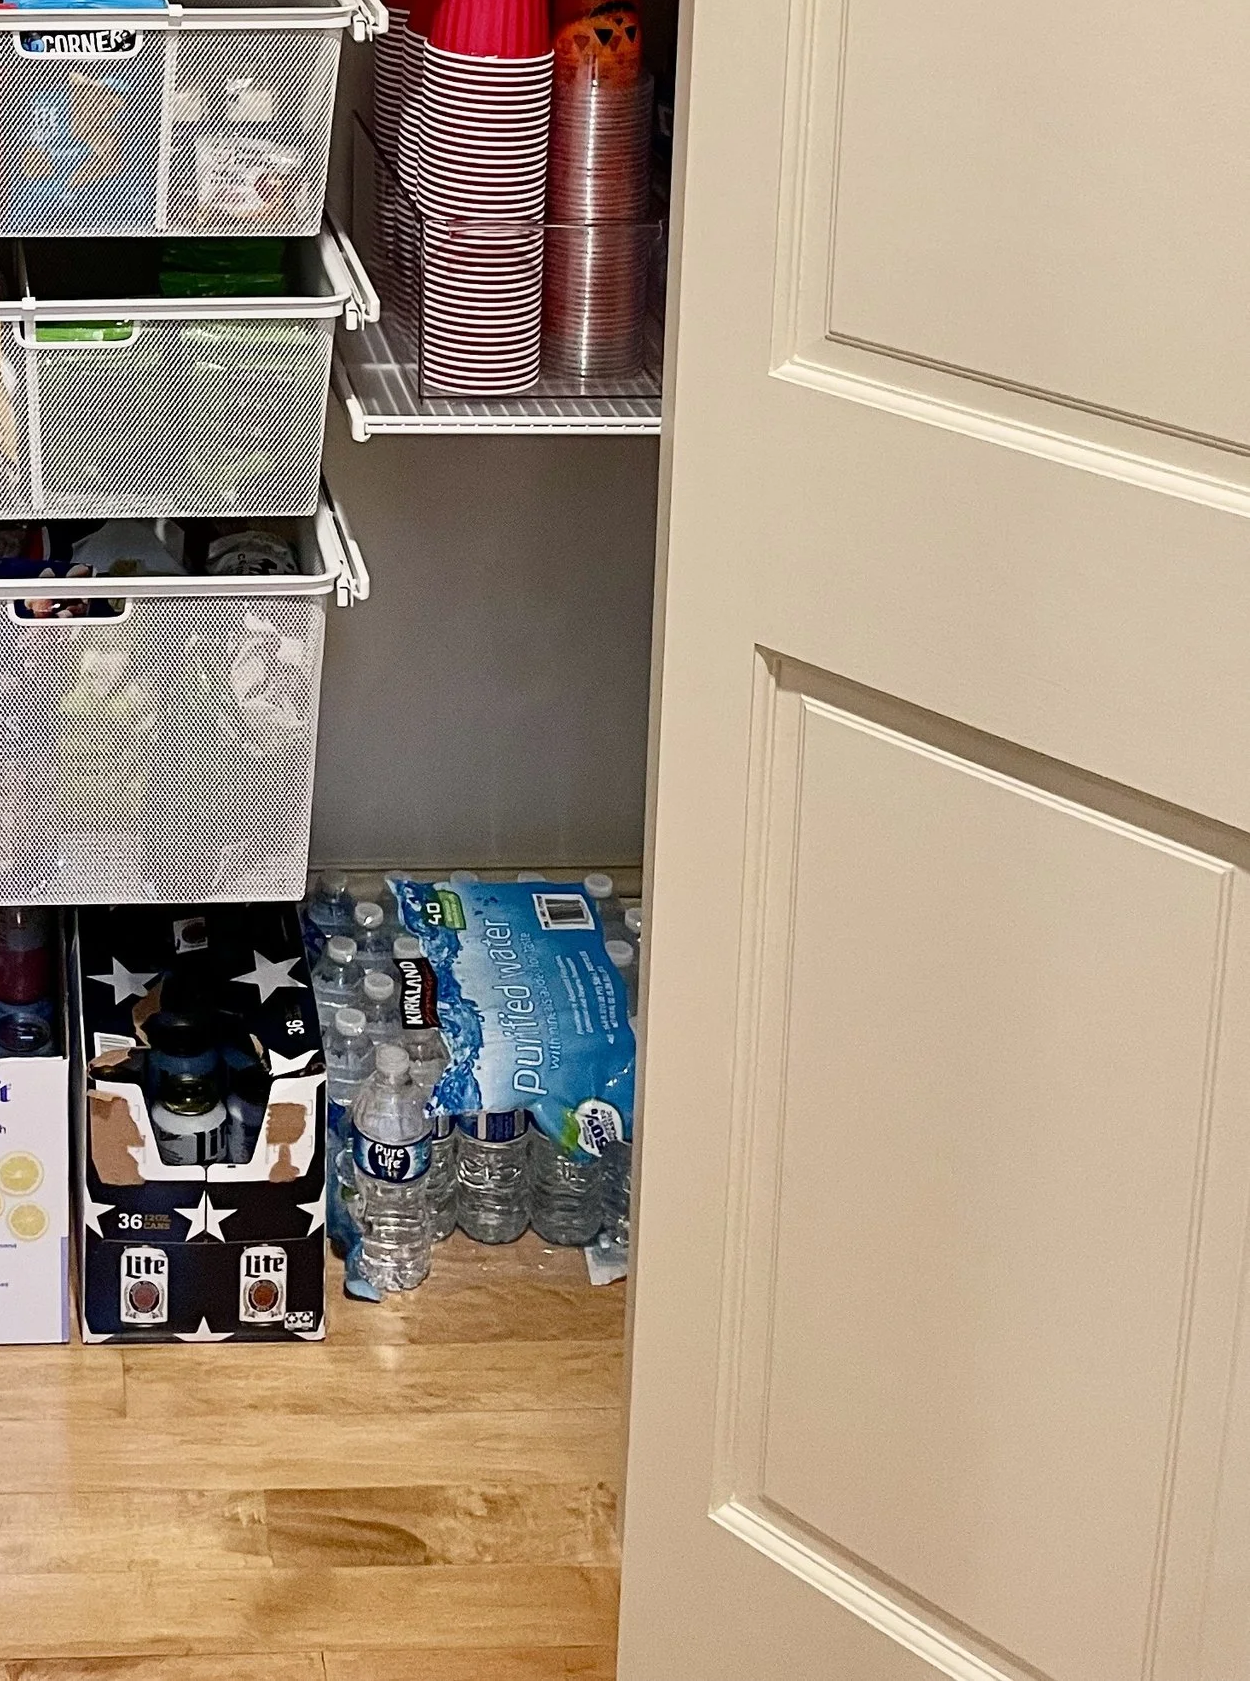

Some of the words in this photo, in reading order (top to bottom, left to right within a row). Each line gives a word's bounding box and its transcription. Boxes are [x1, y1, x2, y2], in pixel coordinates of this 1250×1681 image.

[425, 902, 443, 926] 40
[481, 917, 524, 980] water
[518, 932, 536, 954] taste
[399, 961, 425, 1025] KIRKLAND
[285, 1019, 305, 1035] 36
[493, 985, 549, 1096] purified
[549, 1037, 563, 1070] with
[374, 1143, 405, 1159] Pure
[378, 1155, 402, 1171] Life
[118, 1212, 143, 1230] 36
[143, 1222, 171, 1230] CANS
[125, 1255, 166, 1278] Lite
[245, 1254, 285, 1277] Lite
